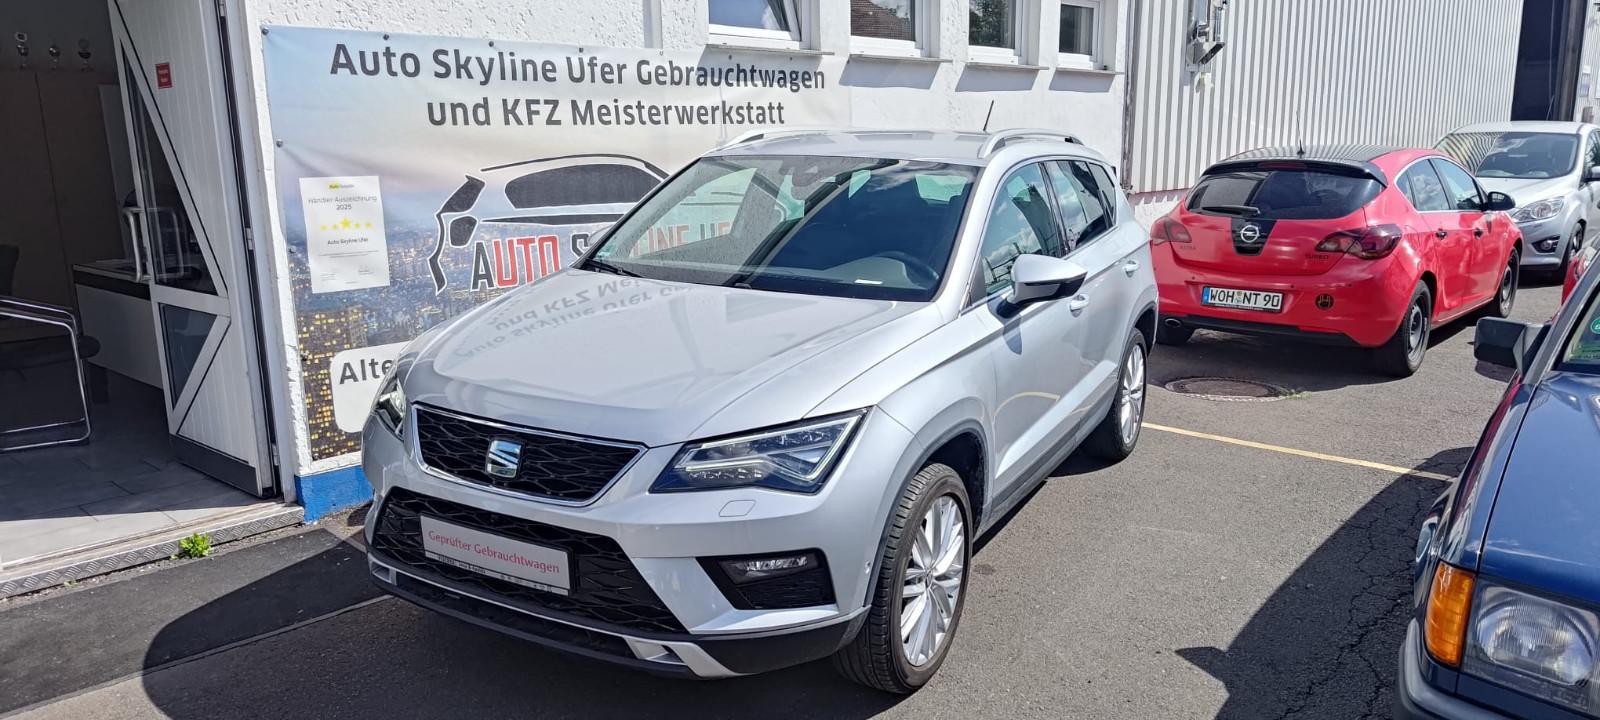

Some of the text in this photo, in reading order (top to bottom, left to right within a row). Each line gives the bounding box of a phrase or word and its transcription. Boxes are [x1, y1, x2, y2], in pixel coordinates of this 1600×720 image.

[330, 43, 825, 93] Auto Skyline Ufer Gebrauchtwagen
[427, 97, 785, 126] und KFZ Meisterwerkstatt
[470, 234, 561, 291] AUTO
[1210, 288, 1235, 304] WOH
[1242, 293, 1262, 306] NT
[1263, 294, 1281, 308] 90
[428, 530, 472, 551] Geprüfter
[473, 543, 560, 573] Gebrauchtwagen
